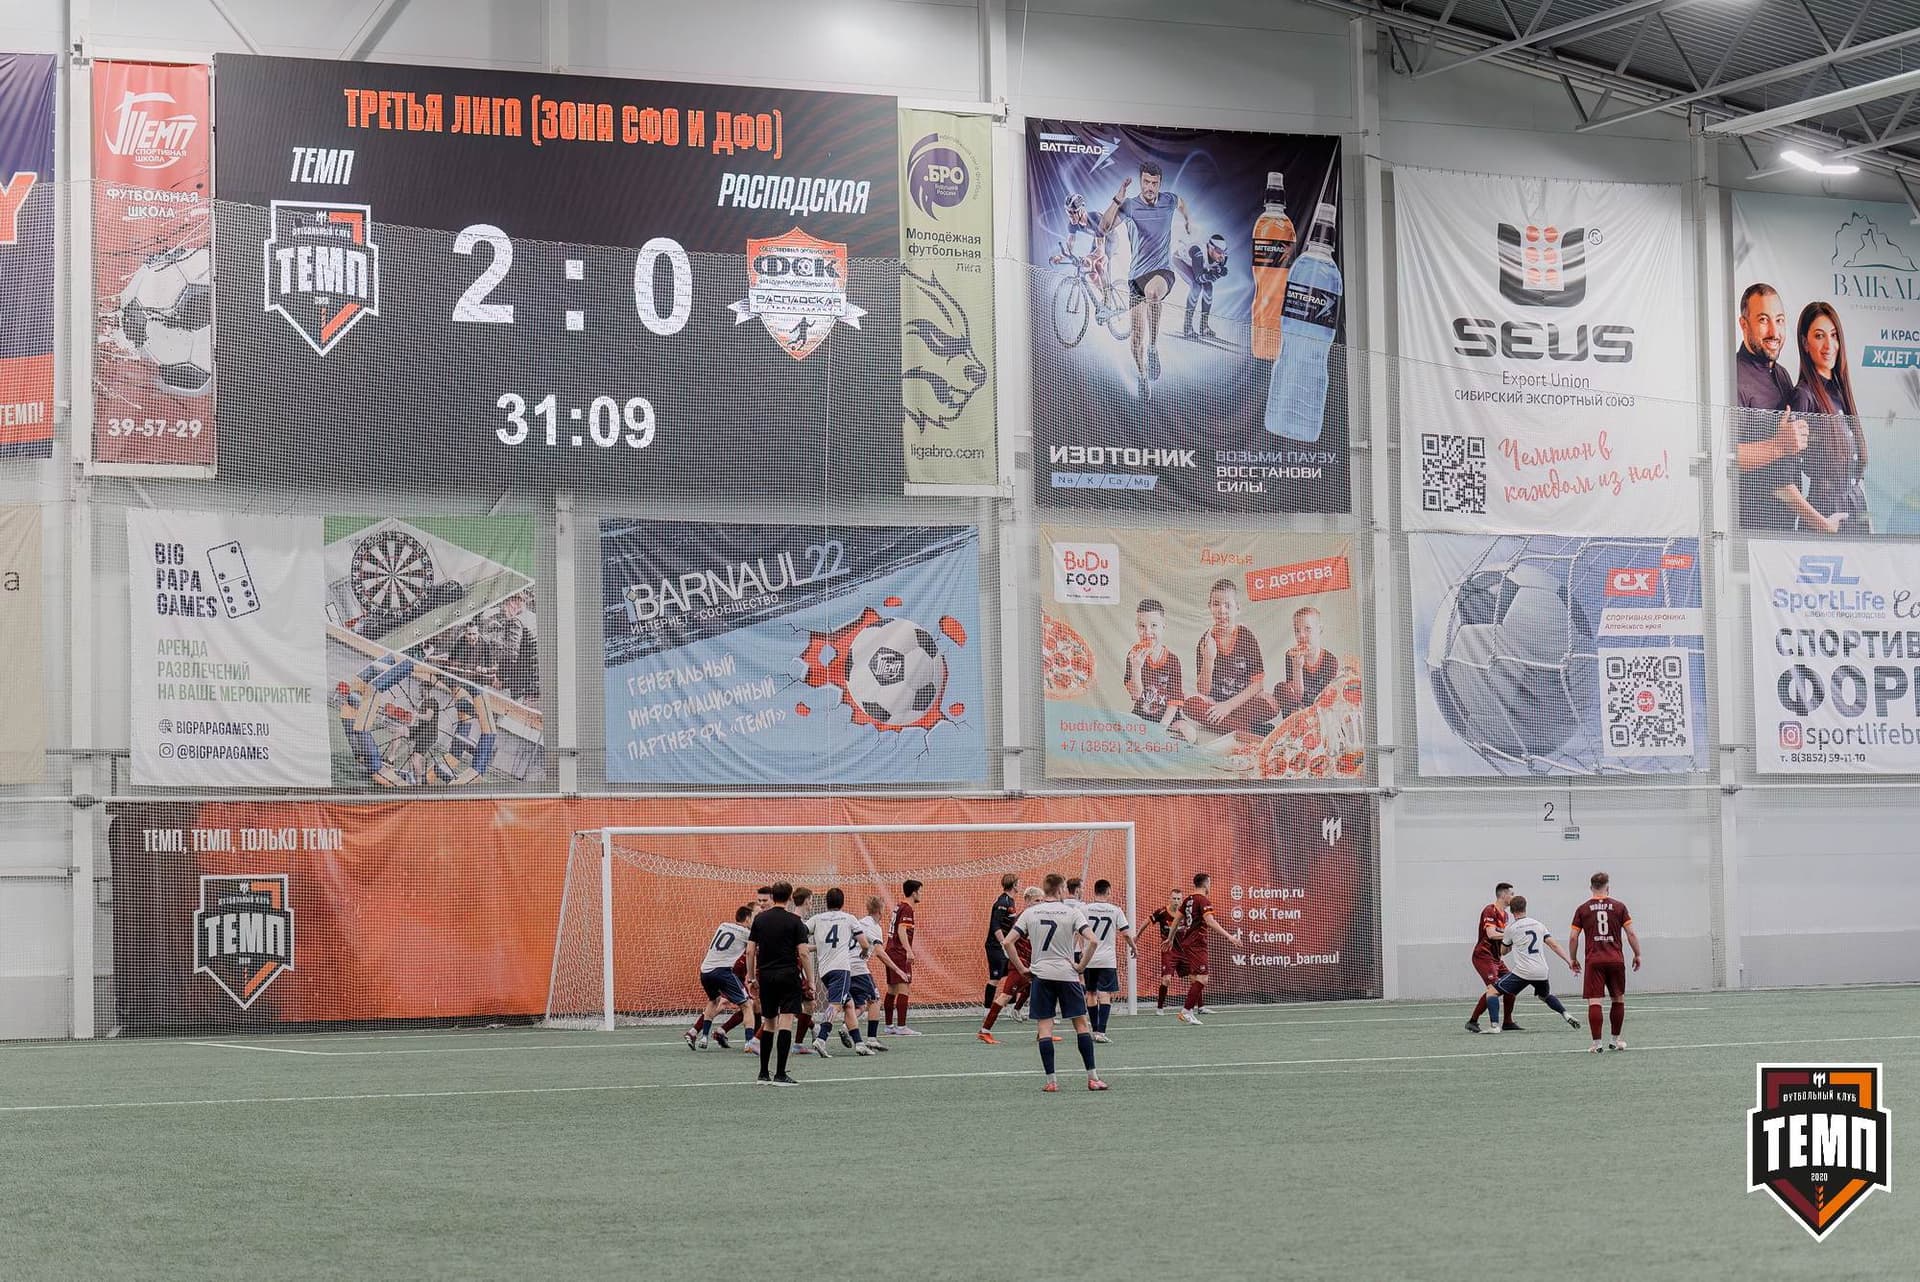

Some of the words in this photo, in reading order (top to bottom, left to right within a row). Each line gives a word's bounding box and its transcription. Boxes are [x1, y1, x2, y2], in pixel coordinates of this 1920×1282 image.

[104, 91, 198, 155] ТЕМП
[344, 88, 443, 134] ТРЕТЬЯ
[452, 95, 522, 138] ЛИГА
[531, 94, 614, 146] (ЗОНА
[622, 106, 681, 146] СФО
[688, 108, 704, 149] И
[711, 107, 784, 160] ДФО)
[135, 148, 187, 157] СПОРТИВНАЯ
[290, 147, 355, 185] ТЕМП
[106, 188, 199, 203] ФУТБОЛЬНАЯ
[717, 172, 870, 216] РАСПАДСКАЯ
[128, 205, 176, 218] ШКОЛА
[906, 227, 982, 245] Молодёжная
[908, 243, 982, 259] футбольная
[276, 246, 368, 299] ТЕМП
[753, 254, 841, 278] ФСК
[452, 223, 514, 323] 2
[634, 237, 693, 335] 0
[1452, 317, 1635, 363] SEUS
[1880, 328, 1889, 340] И
[1871, 349, 1912, 367] ЖДЕТ
[1501, 371, 1548, 388] Export
[1550, 373, 1590, 389] Union
[1454, 389, 1523, 403] СИБИРСКИЙ
[1525, 392, 1603, 406] ЭКСПОРТНЫЙ
[1605, 395, 1636, 407] СОЮЗ
[108, 418, 203, 439] 39-57-29
[496, 393, 656, 448] 31:09
[910, 443, 985, 461] ligabro.com
[1049, 445, 1196, 469] ИЗОТОНИК
[1497, 438, 1596, 471] Чемпион
[1597, 430, 1614, 460] в
[1216, 465, 1322, 479] ВОССТАНОВИ
[1503, 469, 1596, 503] каждом
[1598, 471, 1625, 497] из
[1628, 449, 1670, 484] нас!
[1217, 480, 1268, 493] СИЛЫ.
[155, 541, 185, 566] BIG
[1063, 550, 1109, 571] BuDu
[156, 567, 202, 592] PAPA
[1065, 573, 1110, 586] FOOD
[1254, 577, 1265, 590] с
[1269, 565, 1333, 590] детства
[156, 592, 218, 618] GAMES
[629, 613, 689, 635] ИНТЕРНЕТ
[1605, 614, 1653, 622] СПОРТИВНАЯ
[1653, 614, 1687, 622] ХРОНИКА
[157, 639, 209, 659] АРЕНДА
[157, 660, 251, 681] РАЗВЛЕЧЕНИЙ
[626, 652, 737, 697] ГЕНЕРАЛЬНЫЙ
[157, 683, 178, 700] НА
[180, 683, 217, 702] ВАШЕ
[219, 685, 313, 704] МЕРОПРИЯТИЕ
[1777, 663, 1920, 718] ФОР
[627, 674, 777, 730] ИНФОРМАЦИОННЫЙ
[176, 720, 271, 737] BIGPAPAGAMES.RU
[627, 727, 697, 761] ПАРТНЕР
[700, 720, 727, 742] ФК
[730, 708, 786, 735] «ТЕМП»
[177, 744, 270, 761] @BIGPAPAGAMES
[1060, 740, 1077, 753] +7
[1543, 801, 1555, 822] 2
[143, 829, 187, 854] ТЕМП,
[191, 829, 236, 853] ТЕМП,
[240, 828, 298, 851] ТОЛЬКО
[301, 828, 344, 851] ТЕМП!
[1247, 886, 1305, 900] fctemp.ru
[1248, 907, 1268, 920] ФК
[1270, 907, 1301, 920] Темп
[1596, 910, 1609, 936] 8
[204, 912, 285, 958] ТЕМП
[825, 924, 840, 949] 4
[1040, 919, 1058, 951] 7
[1088, 916, 1113, 941] 77
[1248, 931, 1294, 945] fc.temp
[709, 929, 736, 951] 10
[1525, 929, 1539, 954] 2
[1249, 951, 1340, 968] fctemp_barnaul
